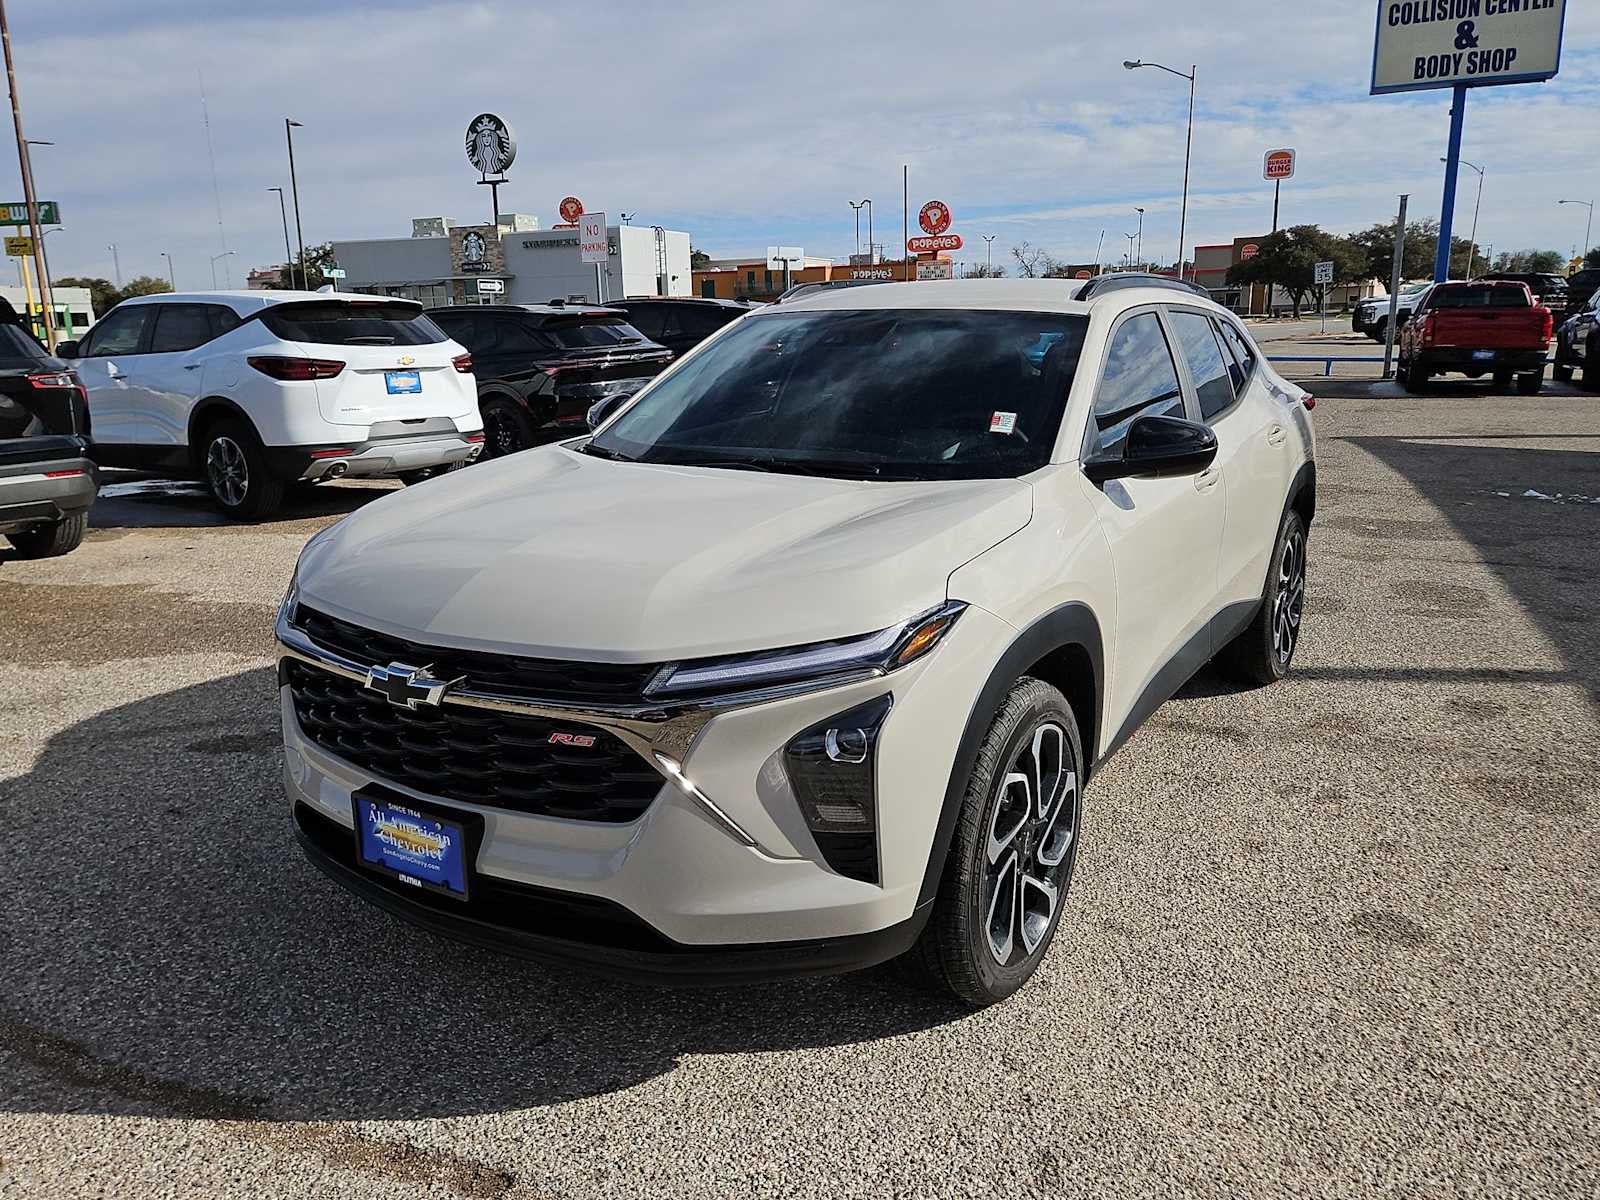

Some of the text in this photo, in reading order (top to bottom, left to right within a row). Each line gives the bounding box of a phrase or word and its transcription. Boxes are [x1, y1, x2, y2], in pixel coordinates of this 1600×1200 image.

[1388, 0, 1480, 27] COLLISION
[1454, 20, 1480, 50] &
[1413, 47, 1517, 80] BODY SHOP
[1267, 164, 1291, 173] KING
[586, 224, 599, 236] NO
[581, 241, 606, 253] PARKING
[1316, 273, 1331, 282] 35
[548, 732, 595, 747] RS
[369, 809, 451, 846] All American
[380, 830, 442, 860] Chevrolet
